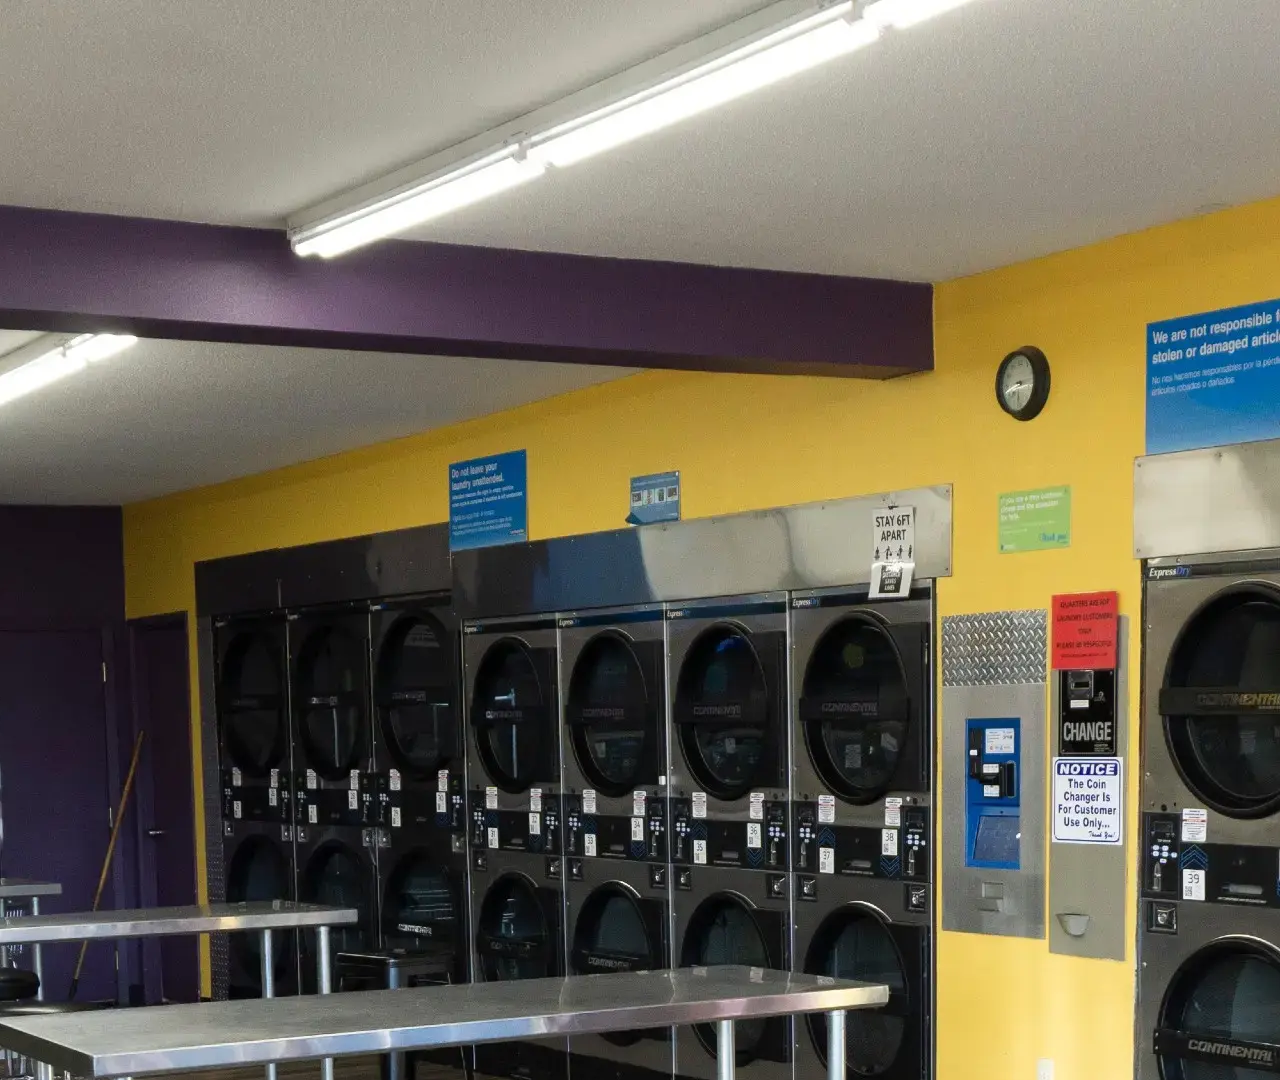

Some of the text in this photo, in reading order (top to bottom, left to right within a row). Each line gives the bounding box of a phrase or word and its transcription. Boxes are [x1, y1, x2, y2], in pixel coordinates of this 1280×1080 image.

[1152, 330, 1169, 345] We
[1170, 328, 1187, 342] are
[1190, 324, 1207, 339] not
[1210, 312, 1273, 335] responsible
[1152, 348, 1183, 365] stolen
[1186, 346, 1198, 359] or
[1199, 335, 1249, 355] damaged
[451, 469, 460, 479] Do
[875, 514, 911, 528] STAY 6FT
[880, 529, 907, 542] APART
[1148, 565, 1192, 578] ExpressDry
[1063, 721, 1112, 742] CHANGE
[1059, 763, 1116, 776] NOTICE
[1067, 778, 1106, 789] The Coin
[1063, 791, 1111, 804] Changer Is
[1058, 803, 1117, 815] For Customer
[1063, 816, 1110, 830] Use Only...
[885, 832, 895, 842] 38
[1187, 873, 1200, 884] 39
[1188, 1039, 1274, 1062] CONTINENTAL
